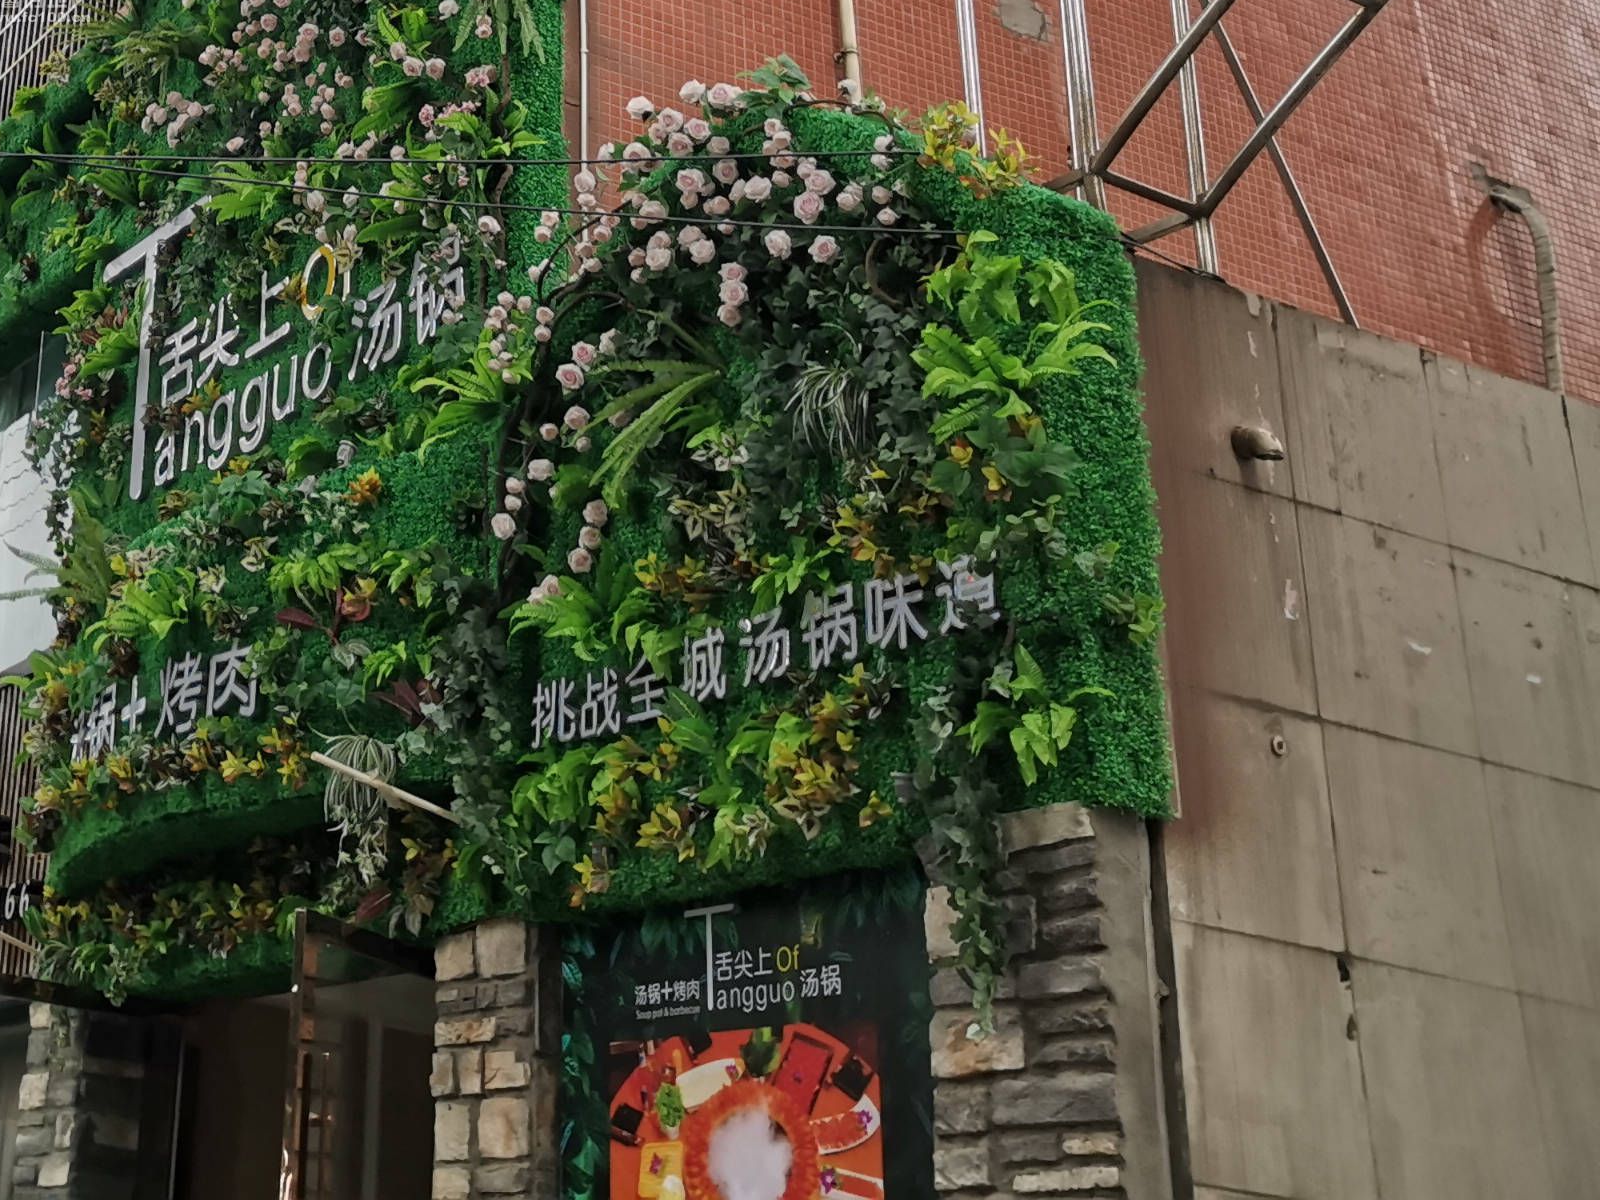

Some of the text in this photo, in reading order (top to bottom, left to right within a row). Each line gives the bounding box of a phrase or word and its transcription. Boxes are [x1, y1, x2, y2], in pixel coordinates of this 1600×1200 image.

[160, 268, 291, 407] 舌尖上
[715, 944, 800, 982] 舌尖上 Of
[800, 963, 842, 998] 汤锅
